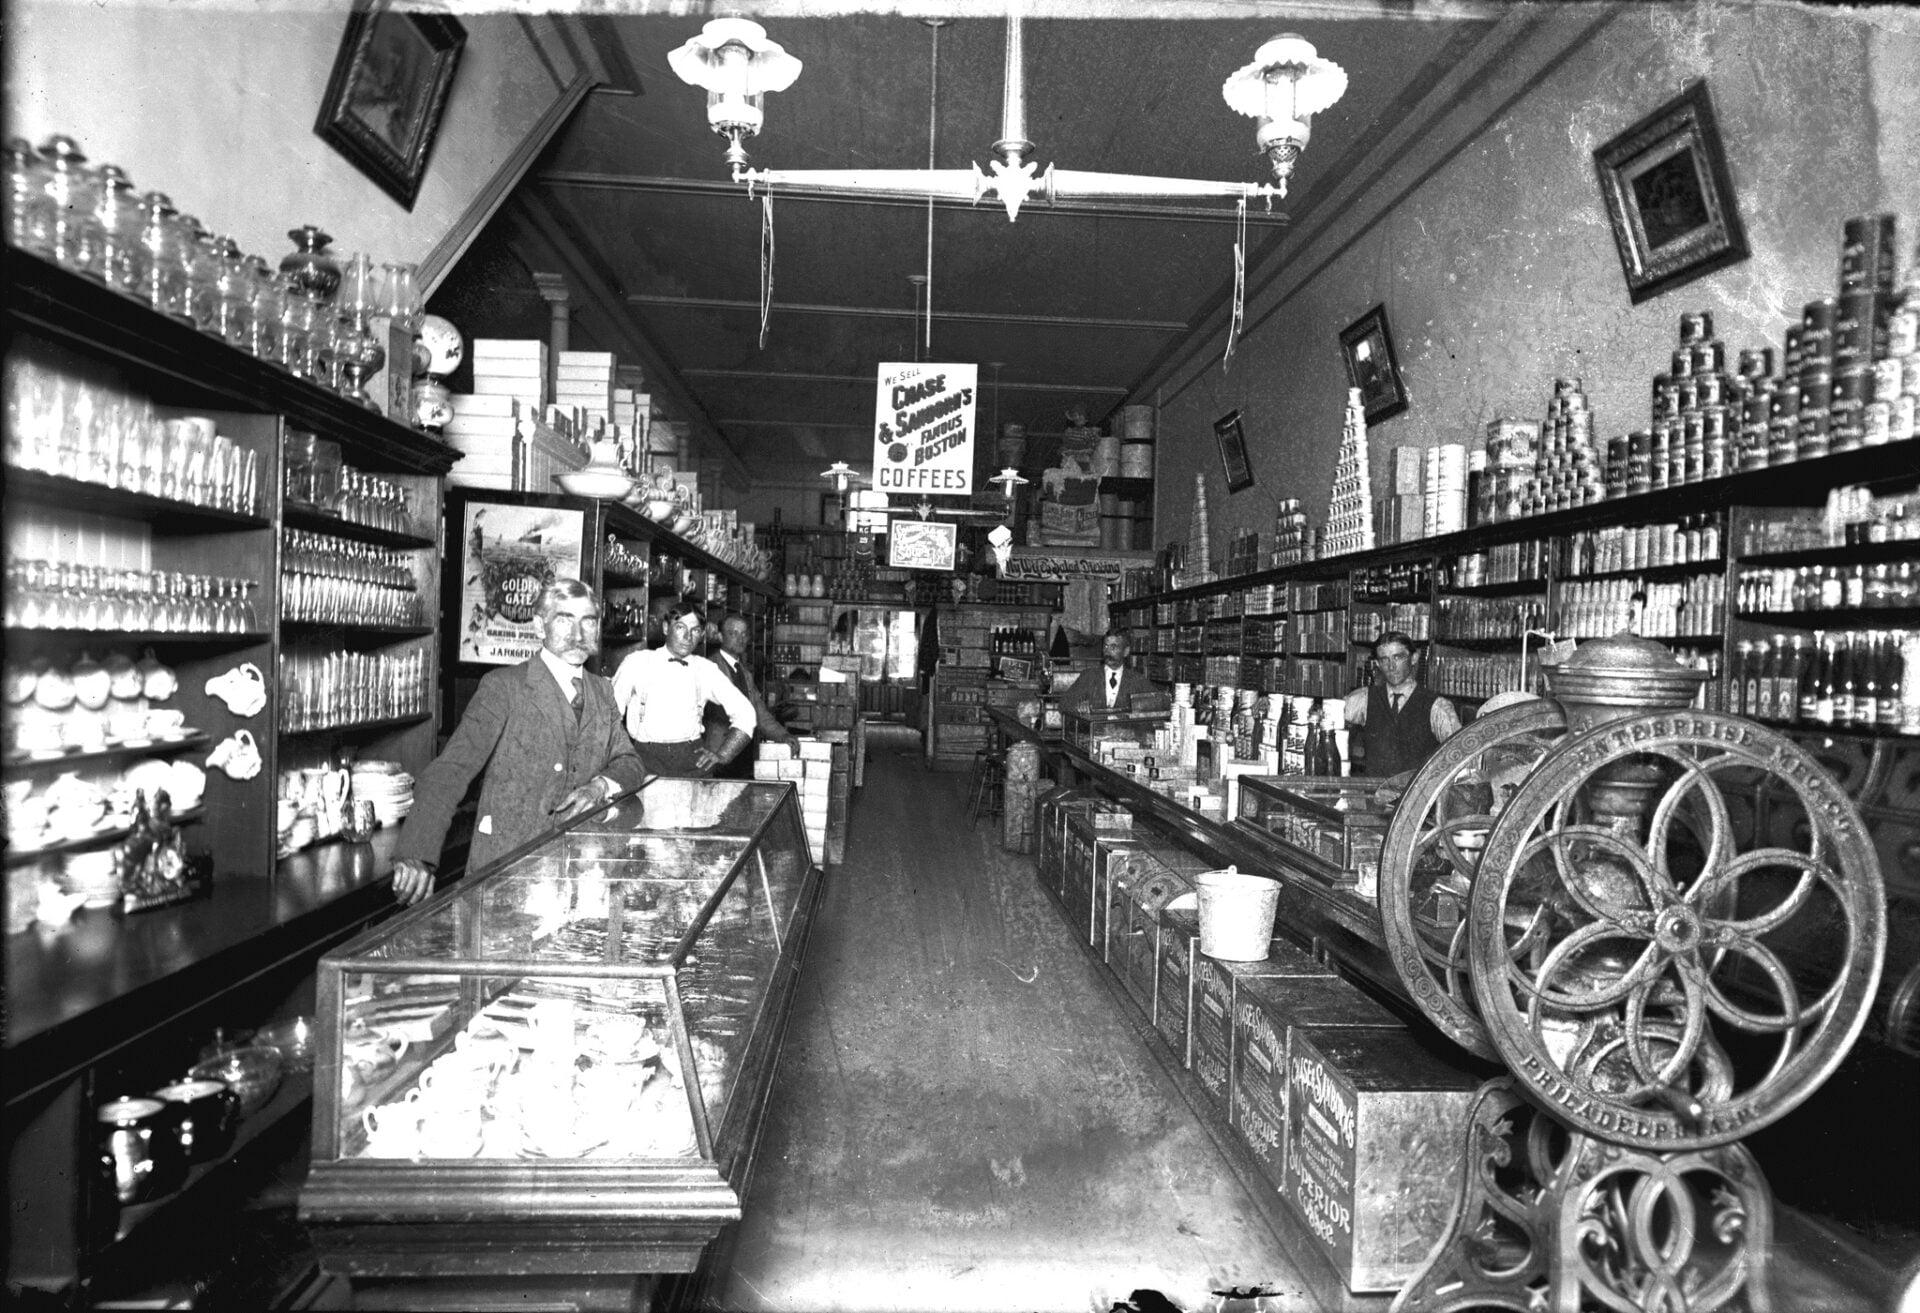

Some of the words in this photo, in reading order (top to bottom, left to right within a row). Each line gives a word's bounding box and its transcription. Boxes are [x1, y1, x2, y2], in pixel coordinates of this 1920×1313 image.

[884, 375, 897, 386] WE
[900, 368, 921, 381] SELL
[891, 373, 946, 411] CHASE
[878, 421, 894, 445] &
[920, 414, 963, 445] FAMOUS
[914, 427, 967, 467] BOSTON
[879, 467, 966, 489] COFFEES
[501, 577, 540, 593] GOLDEN
[505, 592, 533, 605] GATE
[1573, 718, 1755, 765] ENTERPRISE
[1289, 1137, 1351, 1234] SUPERIOR
